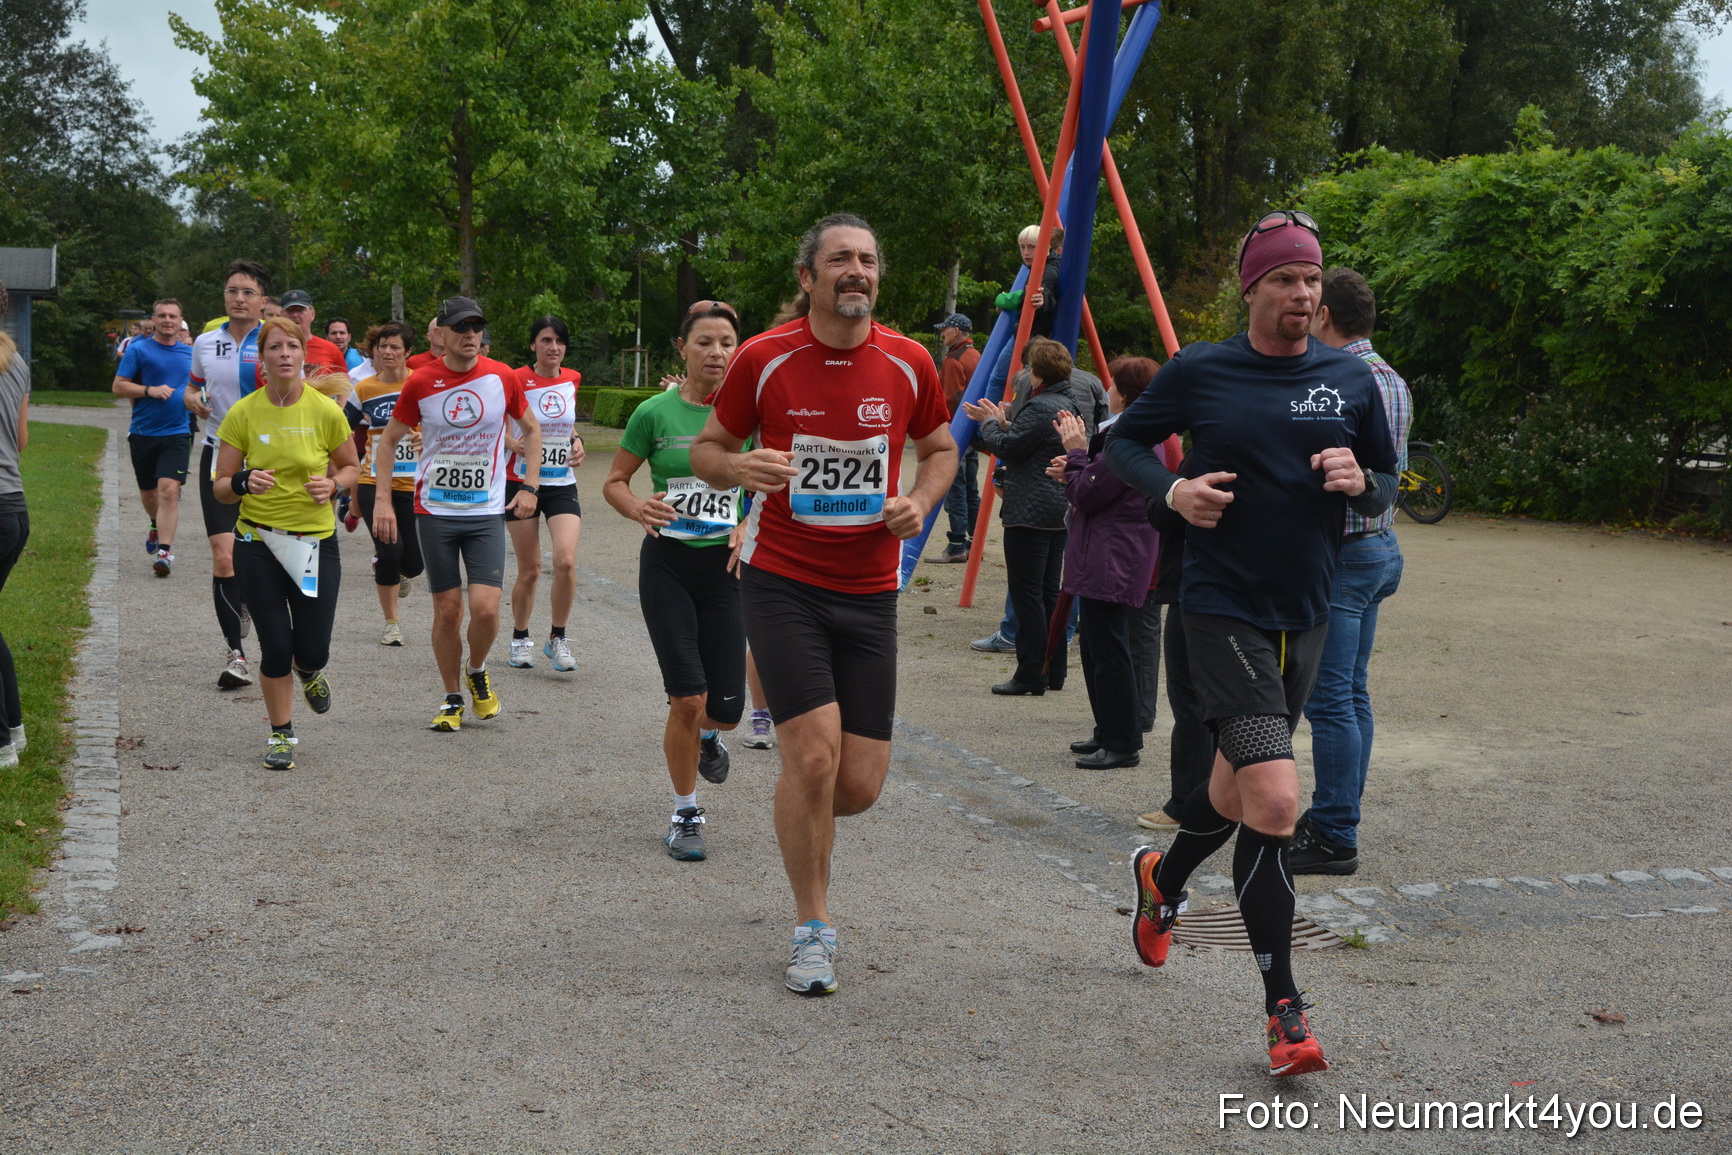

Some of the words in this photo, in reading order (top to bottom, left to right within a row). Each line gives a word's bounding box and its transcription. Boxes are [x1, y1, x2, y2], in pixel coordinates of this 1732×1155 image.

[1290, 400, 1327, 414] Spitz
[793, 443, 826, 453] PARTL
[828, 445, 875, 456] Neumarkt
[435, 466, 485, 489] 2858
[800, 457, 882, 490] 2524
[669, 482, 694, 490] PARTL
[443, 491, 475, 502] Michael
[672, 491, 732, 520] 2046
[813, 498, 867, 513] Berthold
[1227, 635, 1258, 680] SALOMON
